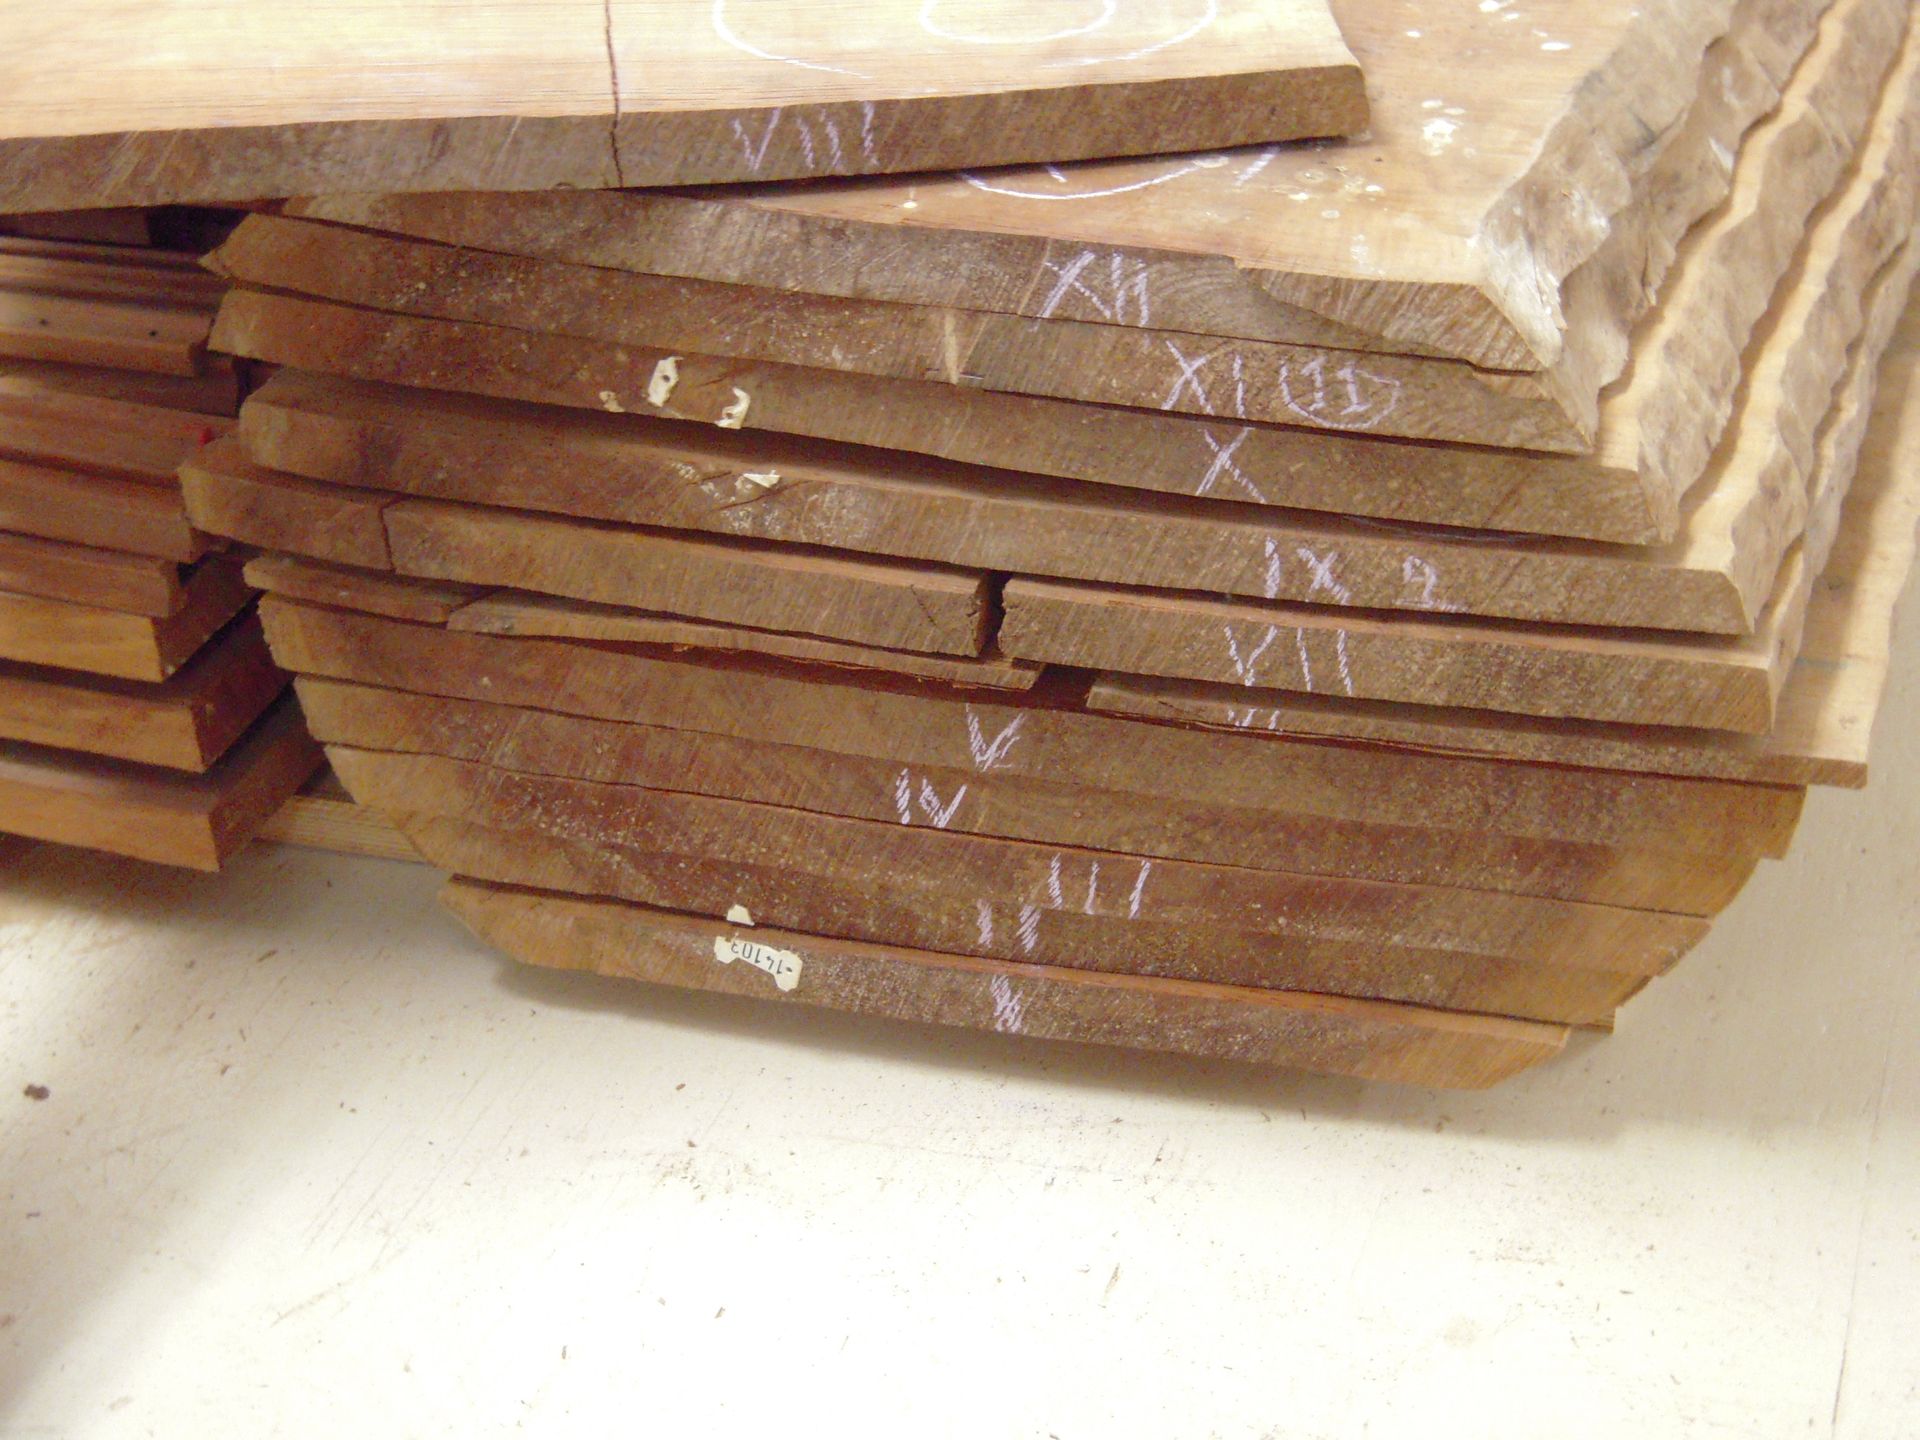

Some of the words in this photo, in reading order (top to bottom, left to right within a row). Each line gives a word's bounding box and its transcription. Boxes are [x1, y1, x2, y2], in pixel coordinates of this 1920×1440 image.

[1160, 340, 1247, 419] XI
[1195, 426, 1268, 504] X
[1224, 625, 1352, 696] VII
